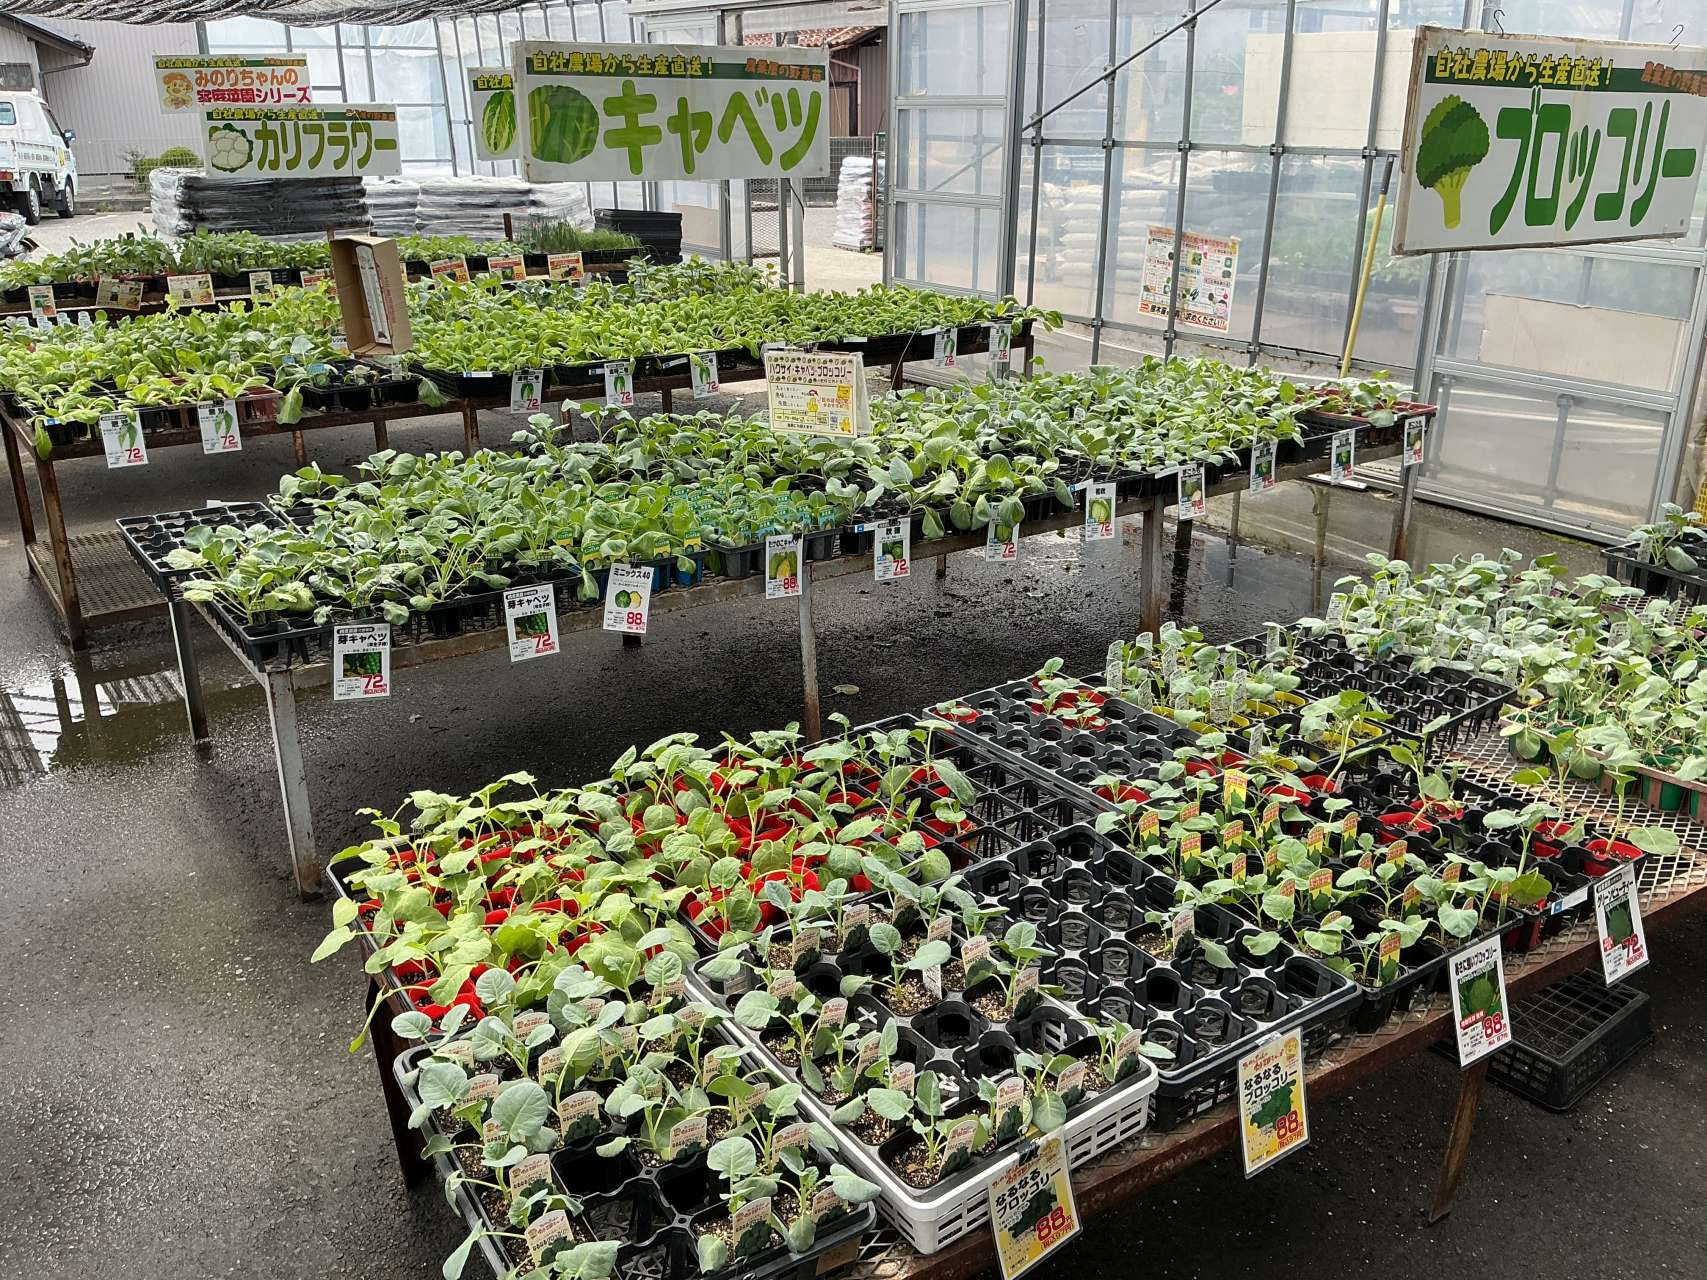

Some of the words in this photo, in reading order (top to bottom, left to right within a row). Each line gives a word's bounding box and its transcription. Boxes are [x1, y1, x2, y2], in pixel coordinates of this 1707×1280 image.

[195, 68, 299, 87] みのりちゃんの
[196, 86, 311, 104] 家庭菜園シリーズ
[603, 80, 823, 175] キャベツ
[254, 119, 397, 172] カリフラワー
[1489, 86, 1697, 236] ブロッコリー
[613, 567, 651, 580] ミニックス40
[507, 594, 550, 610] 芽キャベツ
[337, 633, 387, 645] 芽キャベツ
[1243, 1062, 1282, 1091] なるなる
[1243, 1069, 1298, 1105] ブロッコリー
[995, 1167, 1042, 1208] なるなる
[996, 1167, 1062, 1219] ブロッコリー
